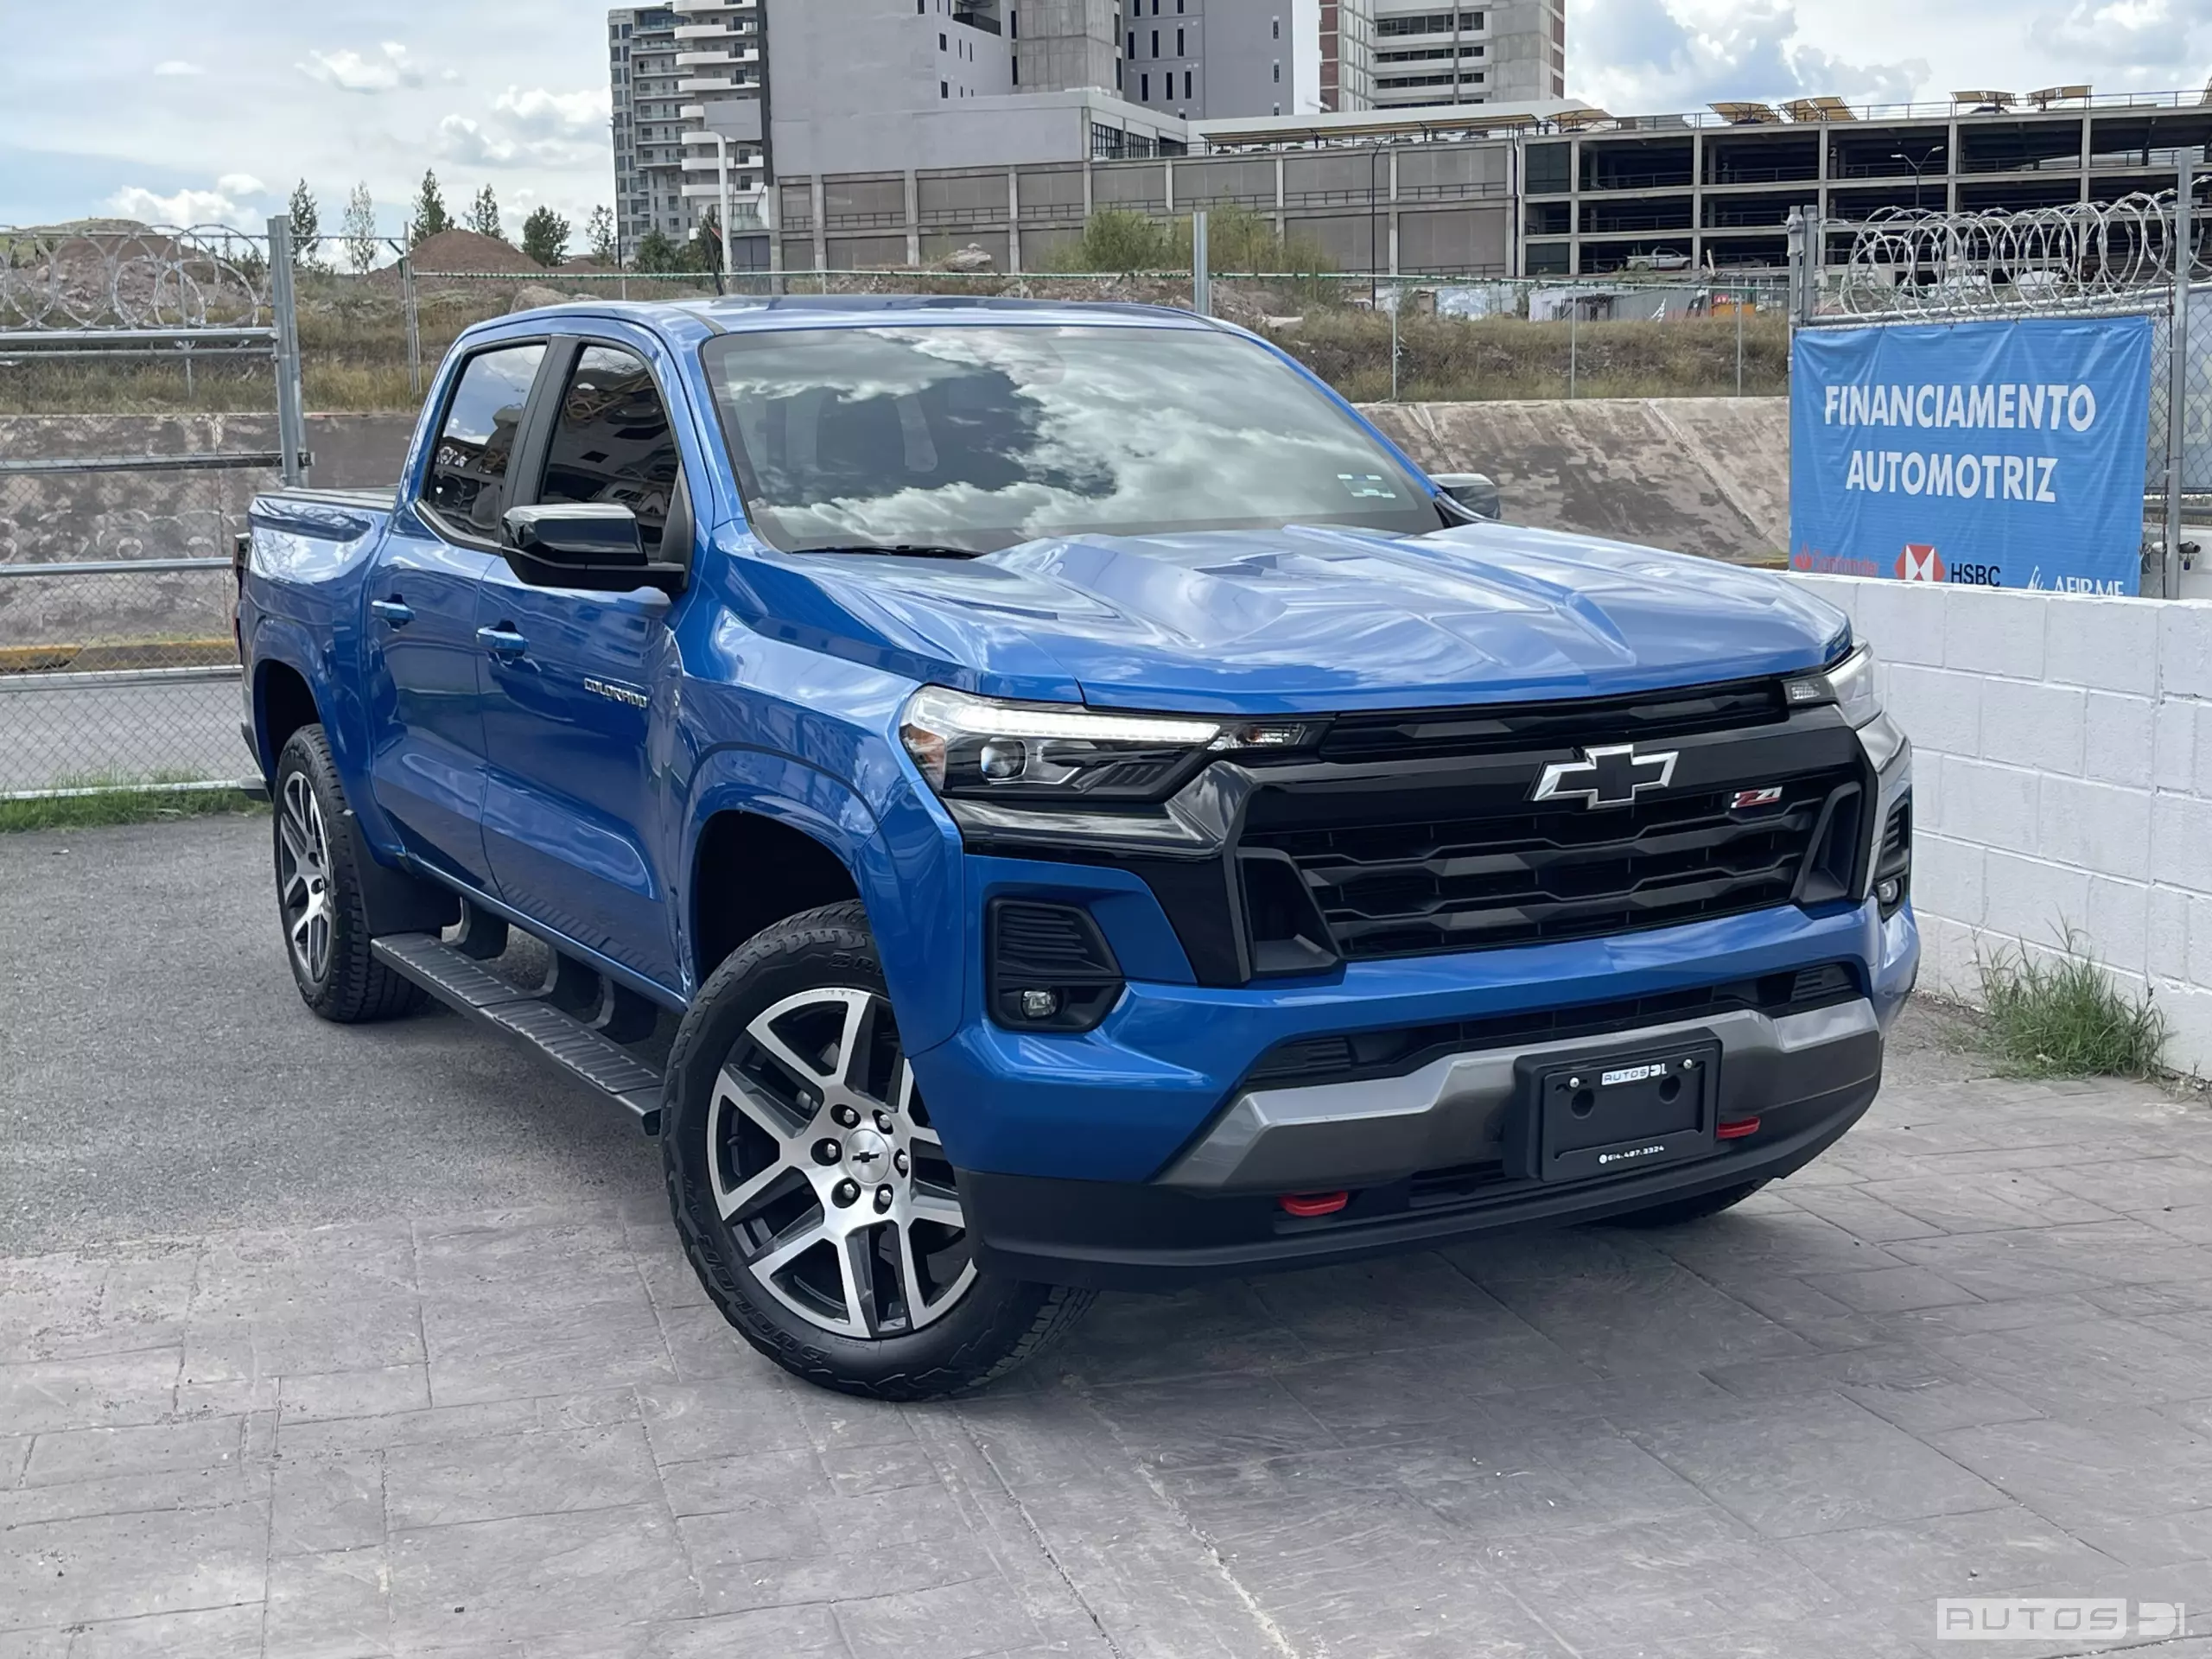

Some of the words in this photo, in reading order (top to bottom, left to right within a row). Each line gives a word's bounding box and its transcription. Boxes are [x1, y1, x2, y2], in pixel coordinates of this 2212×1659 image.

[1824, 384, 2096, 432] FINANCIAMENTO
[1846, 450, 2059, 503] AUTOMOTRIZ
[1950, 563, 2001, 588] HSBC
[583, 677, 648, 709] COLORADO
[1603, 1067, 1649, 1084] AUTOS
